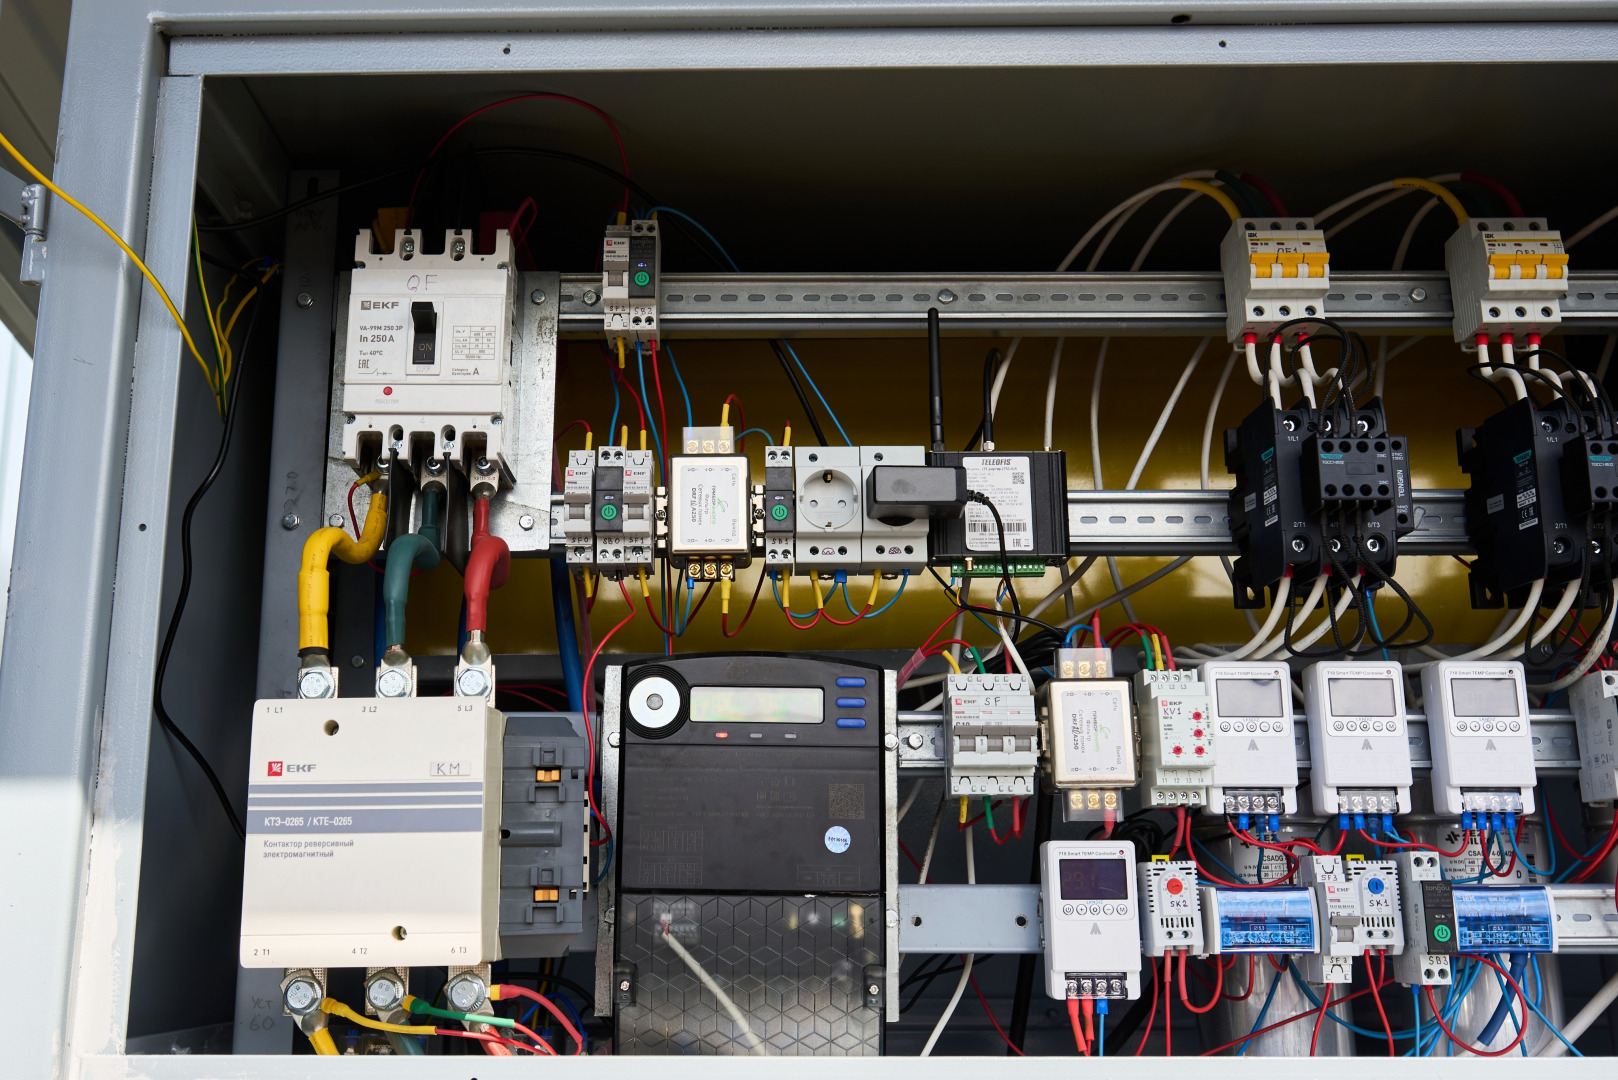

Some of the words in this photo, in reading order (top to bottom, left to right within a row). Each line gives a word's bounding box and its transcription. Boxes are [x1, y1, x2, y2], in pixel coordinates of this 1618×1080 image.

[407, 274, 437, 292] QF
[372, 301, 399, 309] EKF
[359, 335, 368, 343] In
[370, 335, 387, 343] 250
[387, 335, 395, 343] A
[418, 343, 433, 351] ON
[472, 367, 480, 376] A
[1396, 469, 1405, 498] TENGEN
[984, 697, 1001, 707] SF
[1163, 707, 1181, 715] KV1
[286, 764, 317, 773] EKF
[437, 763, 460, 776] KM
[307, 817, 312, 827] /
[263, 840, 303, 848] Контактор
[304, 839, 354, 848] реверсивный
[263, 850, 334, 859] электромагнитный
[1321, 874, 1338, 882] SF3
[1516, 870, 1522, 879] D
[1170, 900, 1188, 908] SK2
[1369, 899, 1390, 907] SK1
[1428, 956, 1448, 966] SB3
